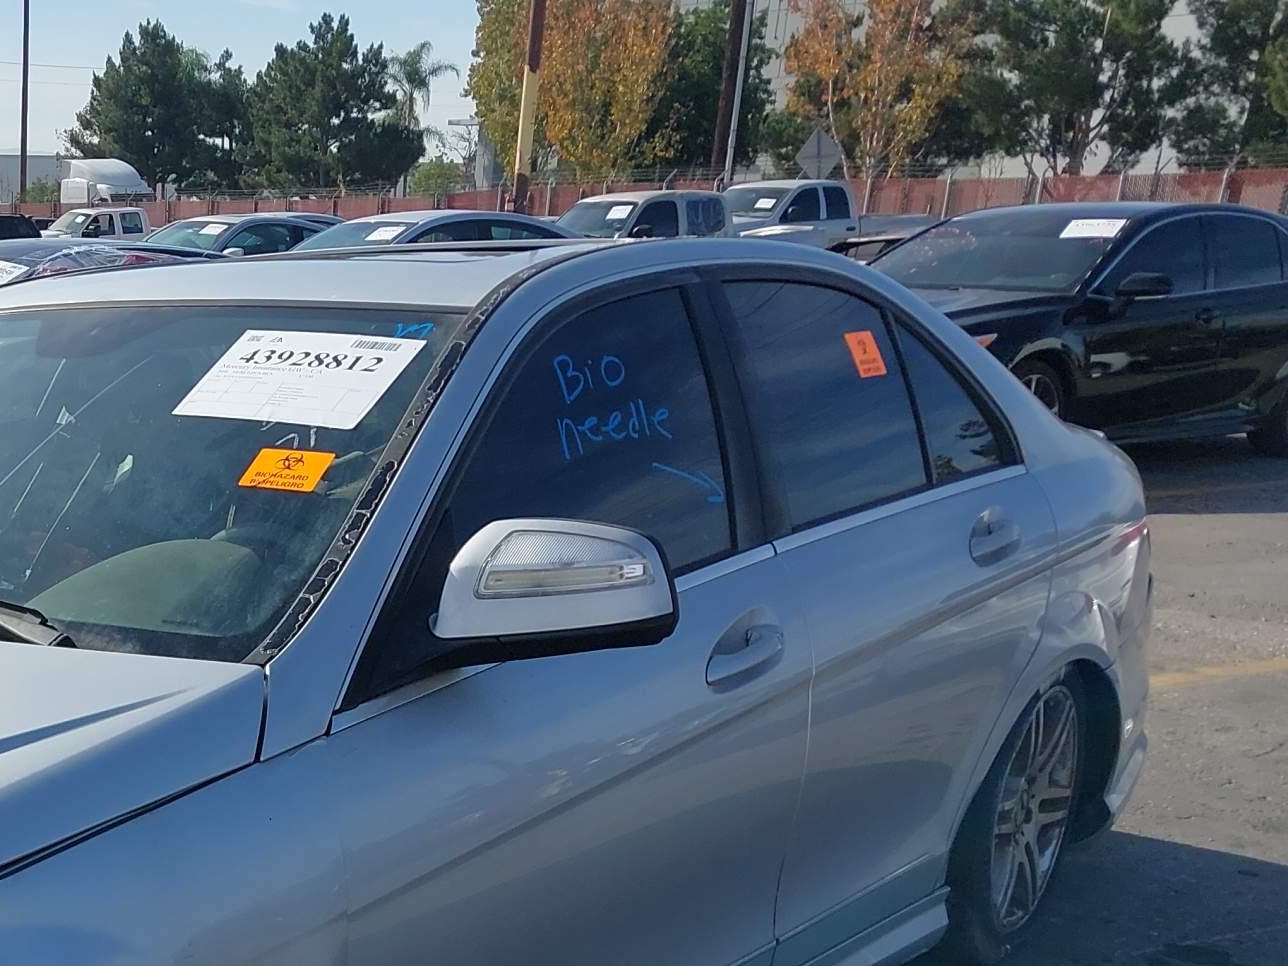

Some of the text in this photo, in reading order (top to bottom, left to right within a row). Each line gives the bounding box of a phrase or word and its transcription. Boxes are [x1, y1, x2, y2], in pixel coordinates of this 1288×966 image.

[239, 348, 384, 373] 43928812
[557, 399, 673, 460] needle
[254, 471, 309, 482] BIOHAZARD
